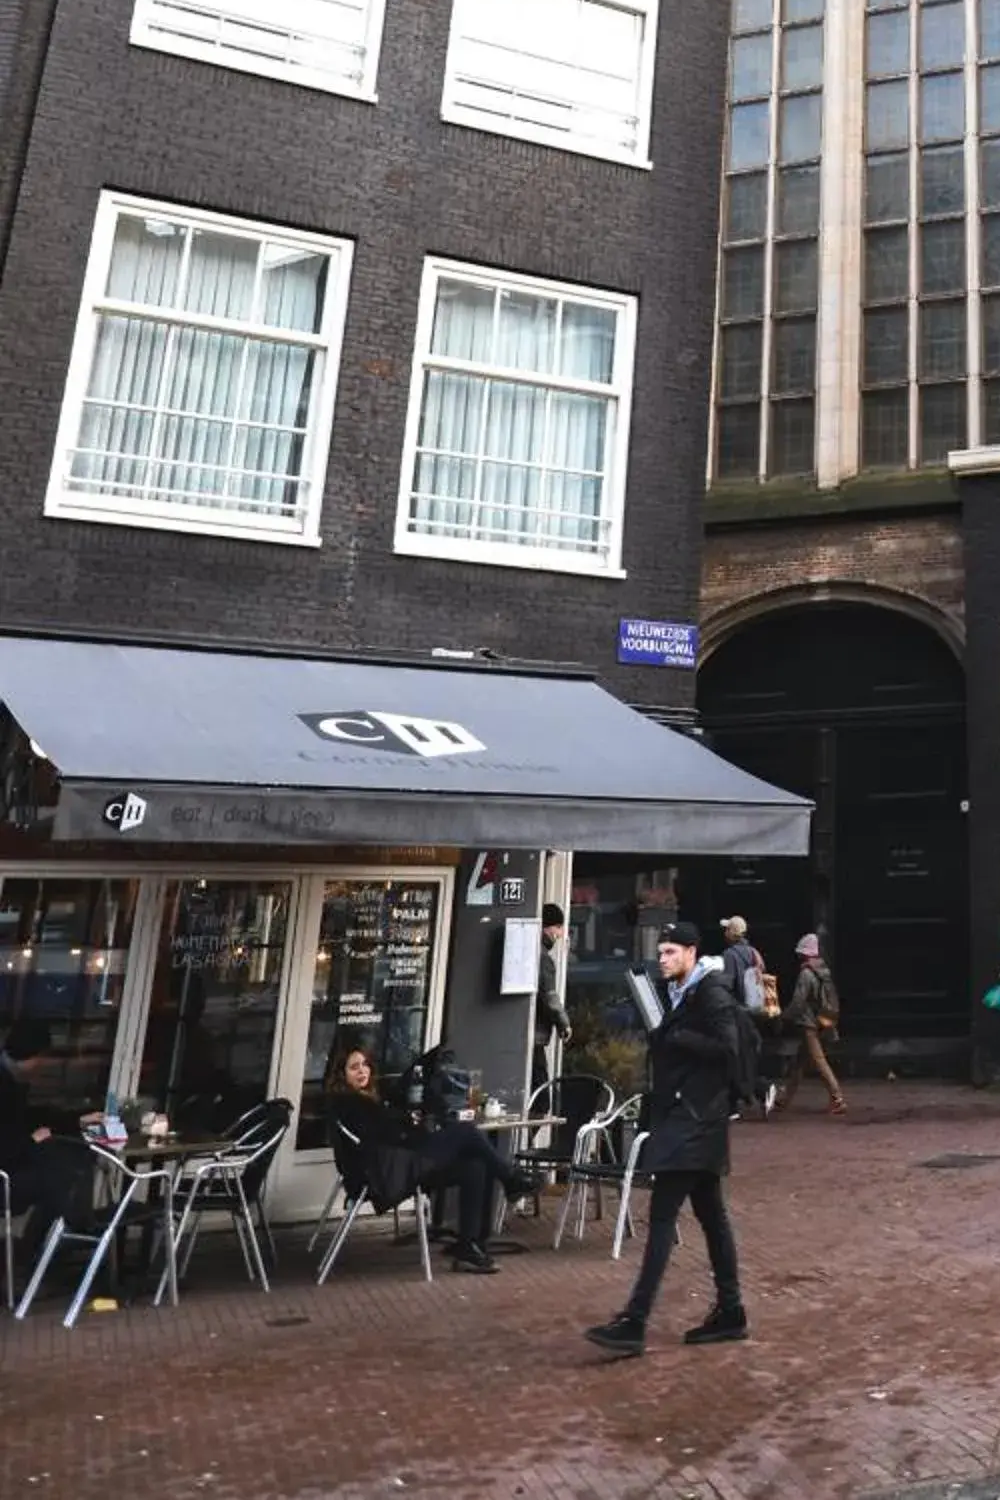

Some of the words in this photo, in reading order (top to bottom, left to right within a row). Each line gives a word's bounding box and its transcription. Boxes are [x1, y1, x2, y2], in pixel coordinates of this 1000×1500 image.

[621, 637, 695, 656] VOORBURGWAL
[503, 882, 522, 901] 121
[393, 908, 430, 920] PALM
